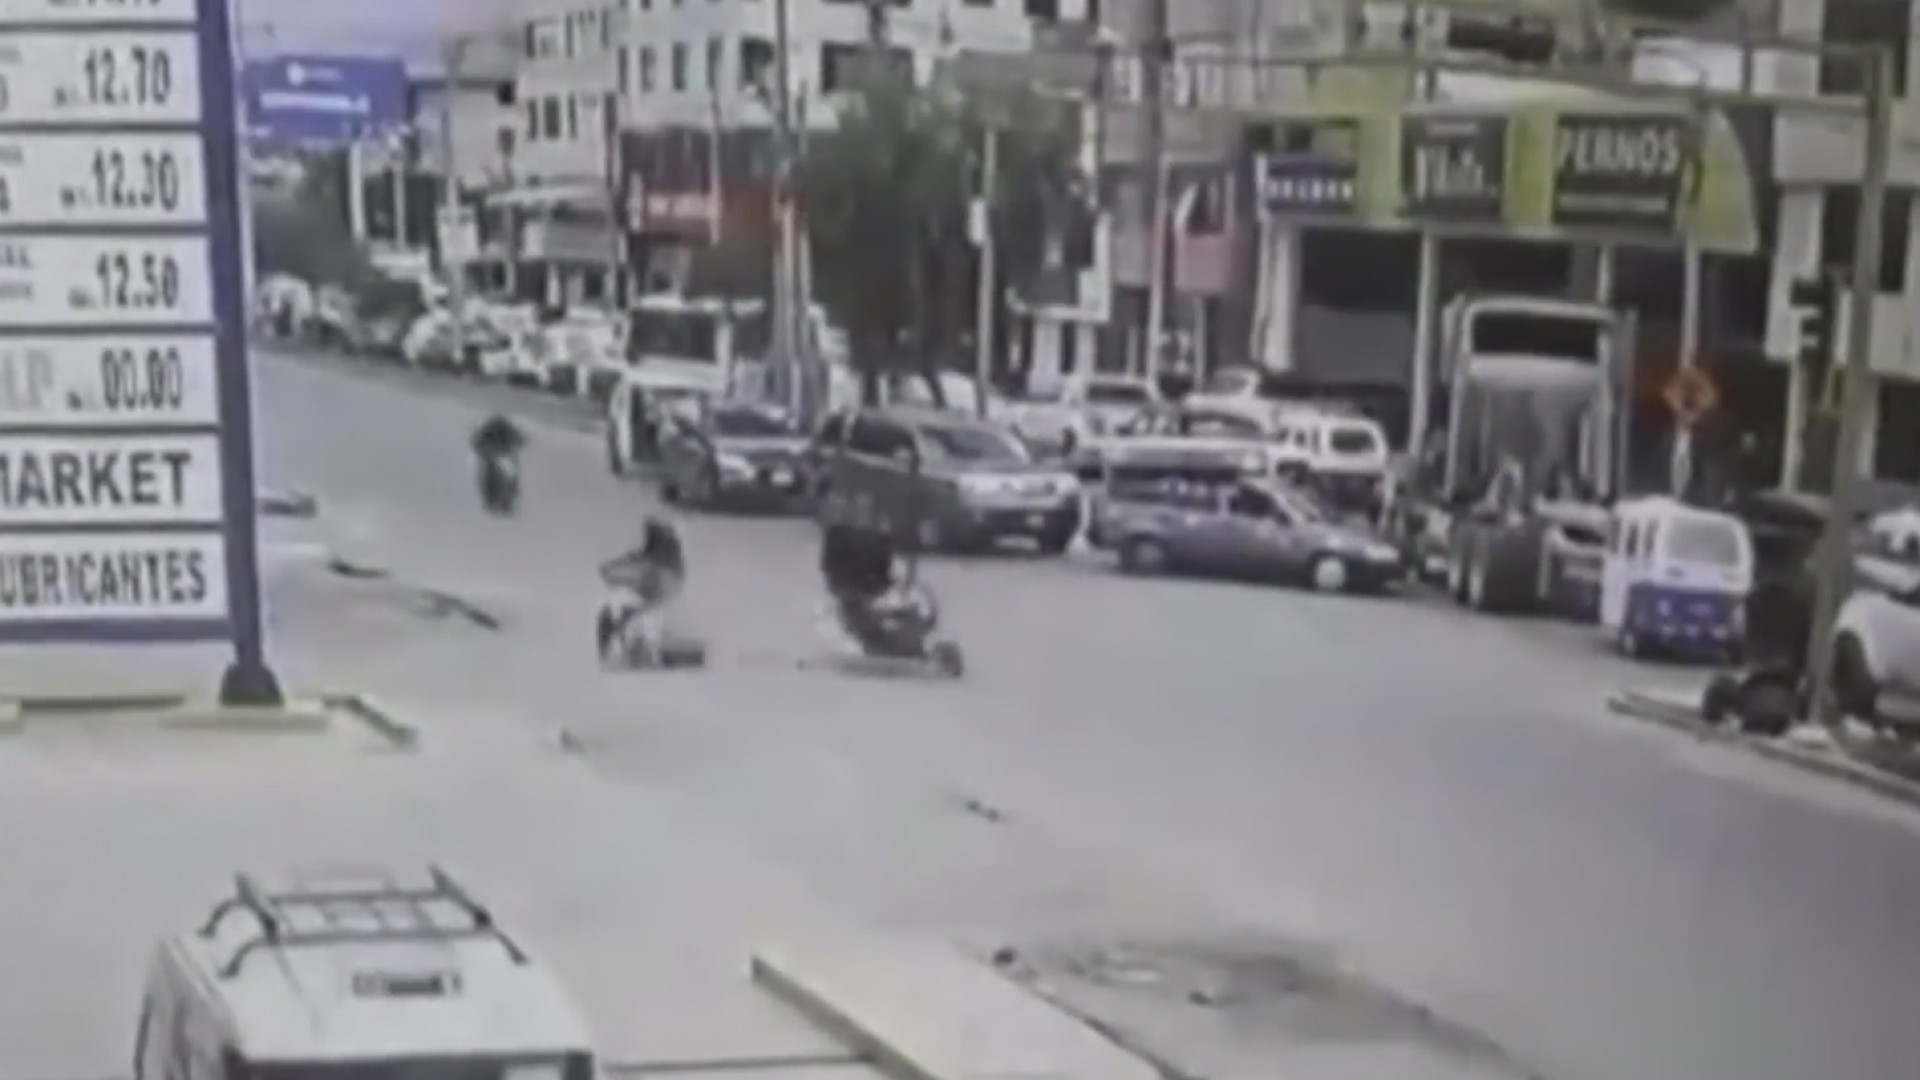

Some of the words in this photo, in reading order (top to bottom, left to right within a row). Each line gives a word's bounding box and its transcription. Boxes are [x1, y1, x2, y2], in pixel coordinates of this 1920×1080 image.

[85, 46, 171, 105] 12.70
[93, 149, 179, 211] 12.30
[96, 251, 179, 309] 12.50
